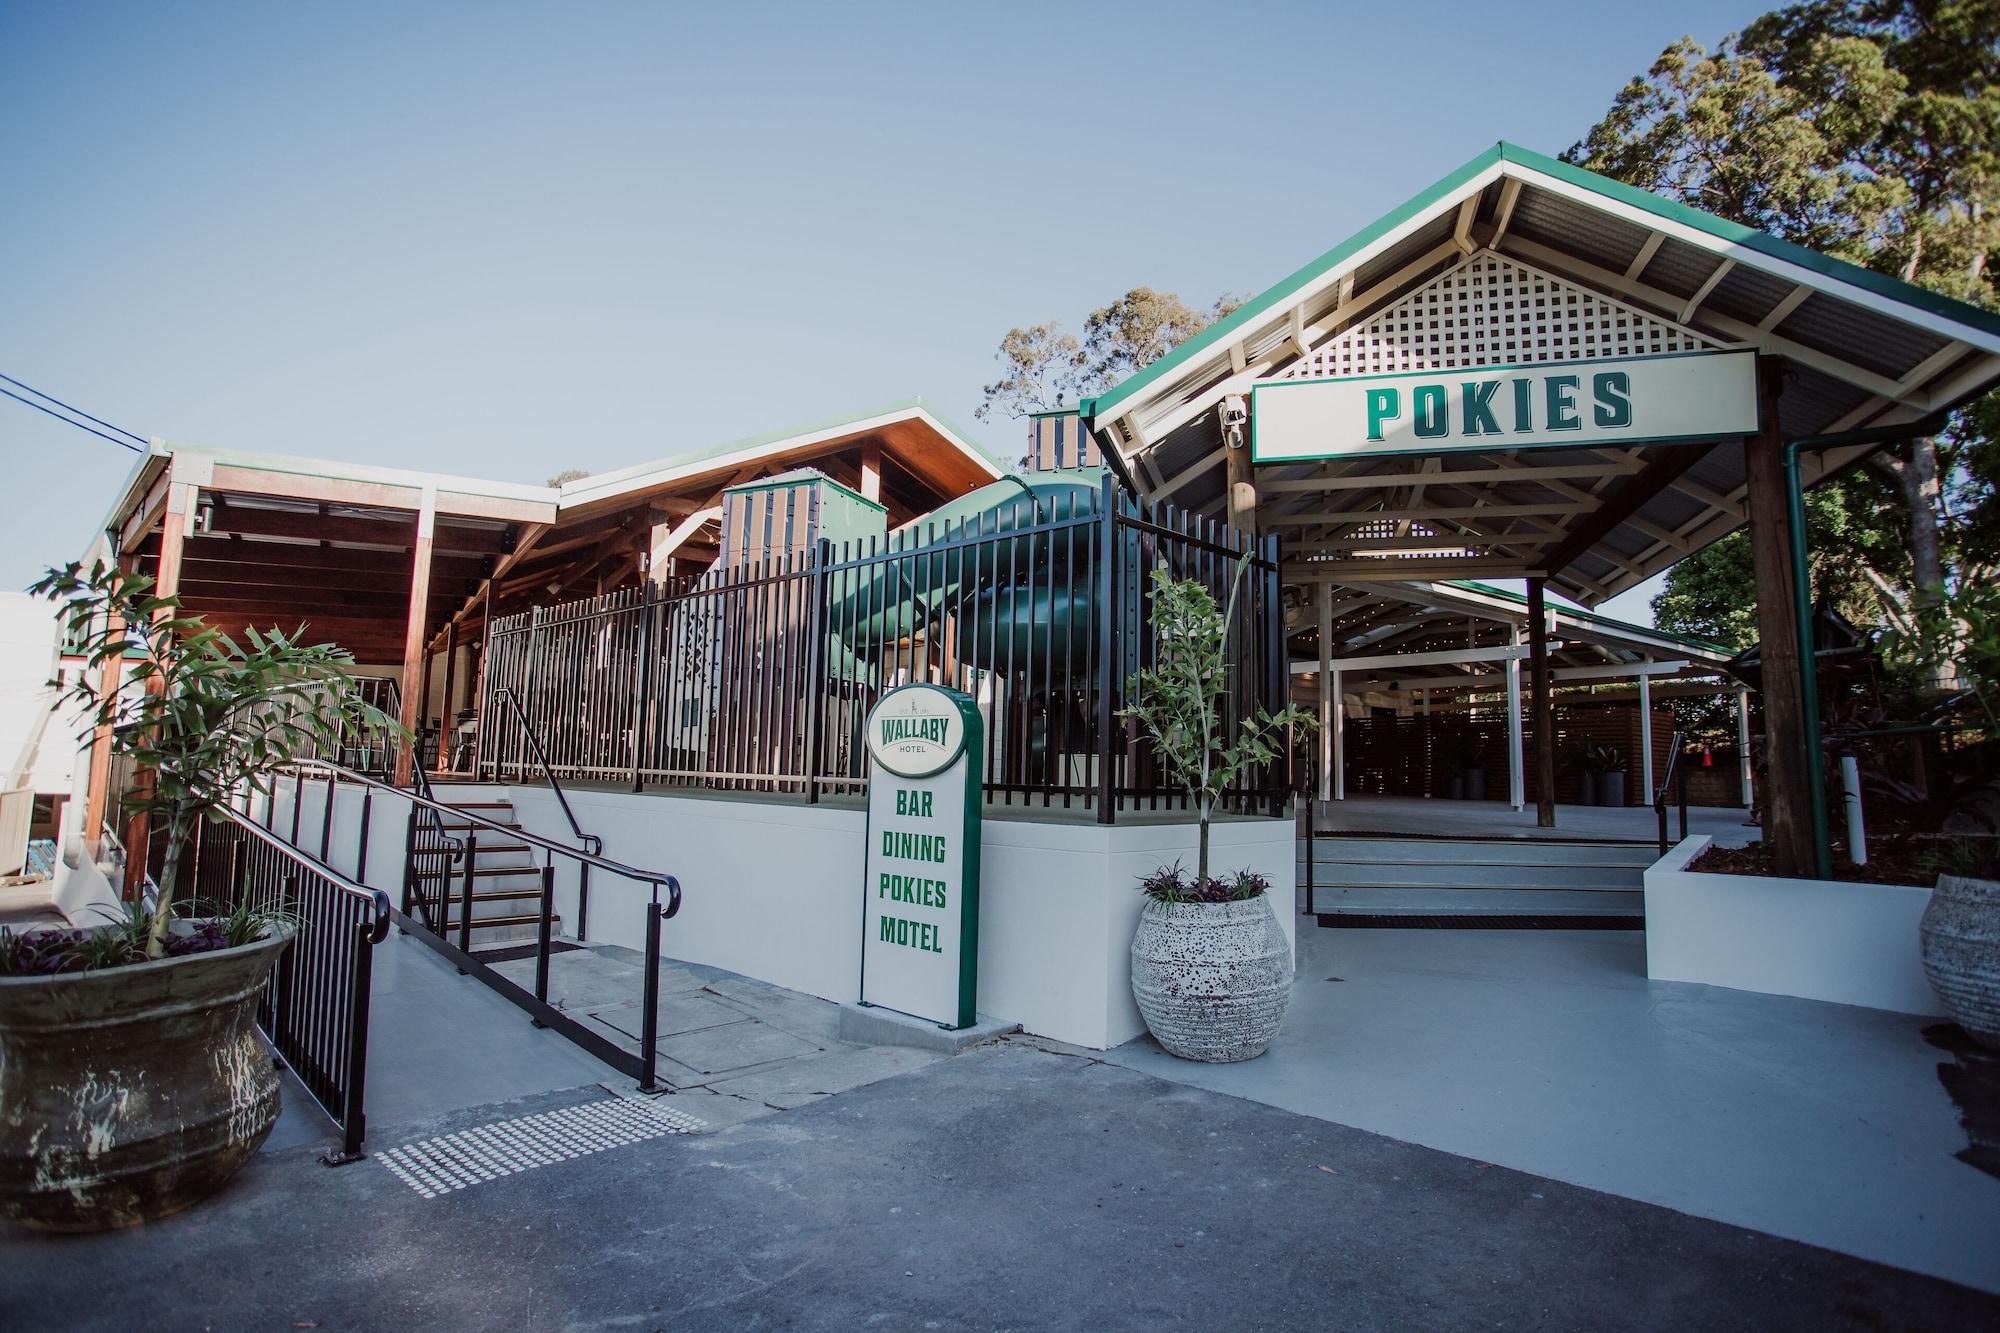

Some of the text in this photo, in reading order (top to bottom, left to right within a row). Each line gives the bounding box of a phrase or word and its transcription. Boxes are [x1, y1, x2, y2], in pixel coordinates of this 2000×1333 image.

[1366, 372, 1632, 442] POKIES
[882, 718, 949, 746] WALLABY
[899, 745, 926, 753] HOTEL
[896, 789, 933, 818] BAR
[882, 831, 945, 863] DINING
[880, 873, 946, 909] POKIES
[880, 916, 942, 953] MOTEL
